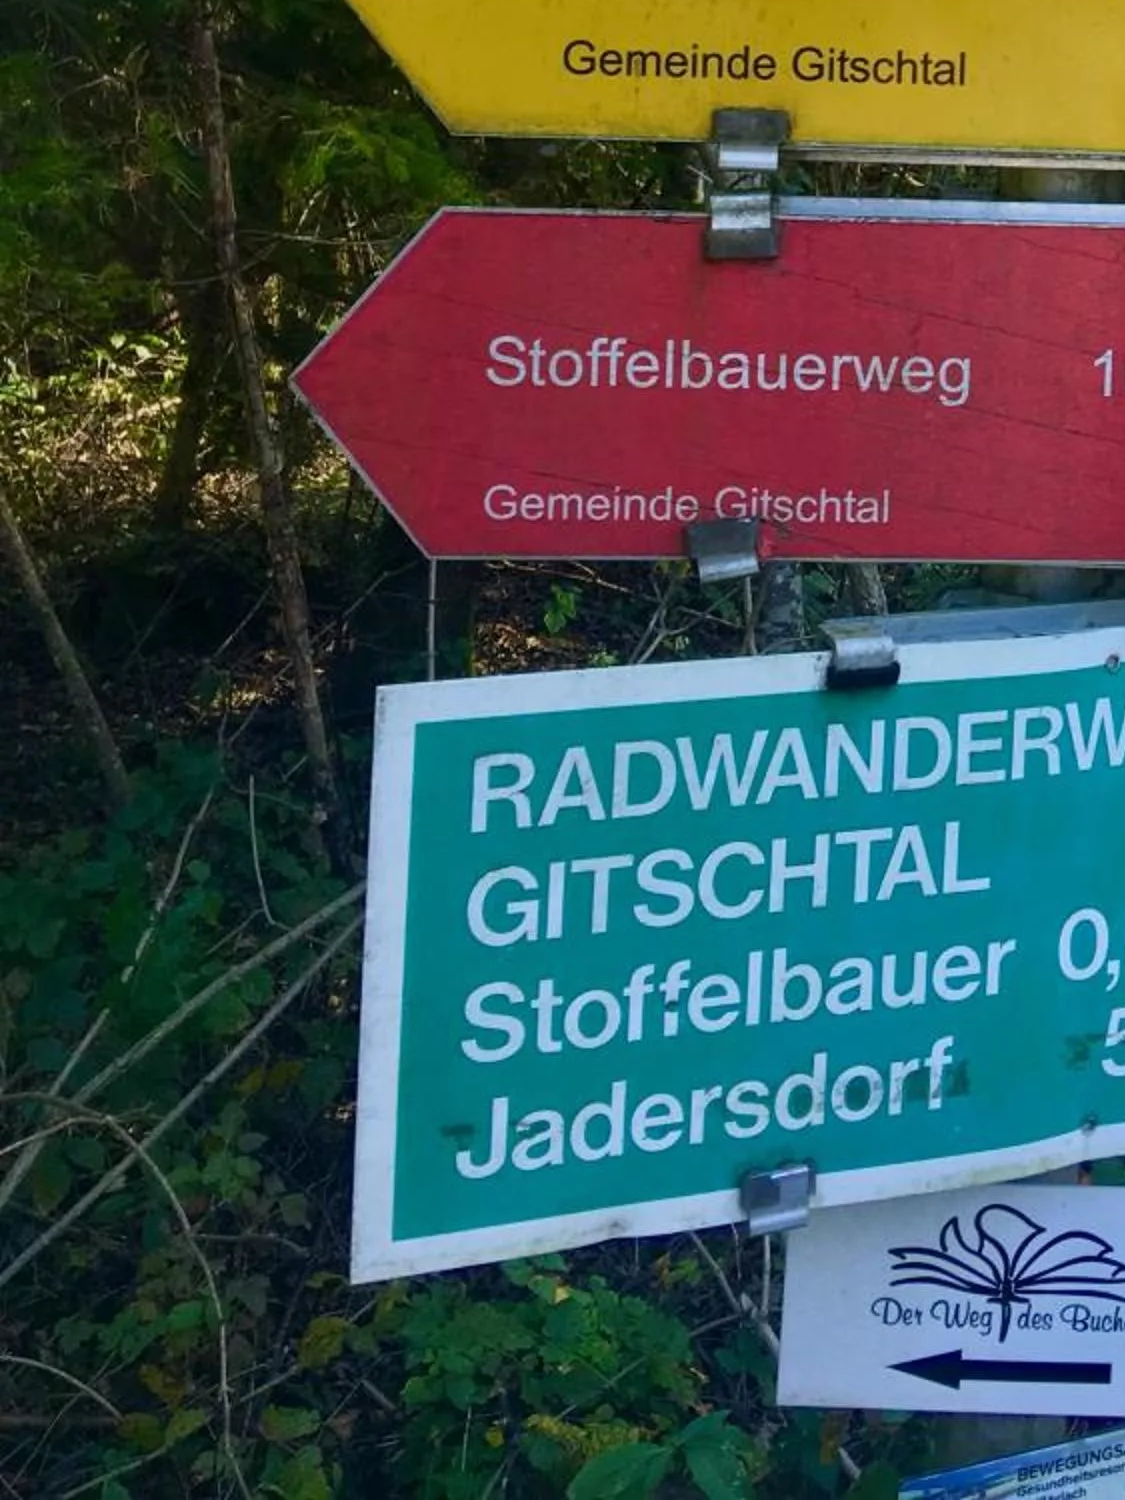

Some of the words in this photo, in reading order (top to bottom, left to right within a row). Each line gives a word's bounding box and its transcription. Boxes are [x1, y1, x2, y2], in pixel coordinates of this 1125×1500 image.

[562, 40, 777, 81] Gemeinde
[791, 47, 967, 87] Gitschtal
[485, 334, 972, 407] Stoffelbauerweg
[483, 483, 700, 523] Gemeinde
[715, 484, 890, 524] Gitschtal
[466, 821, 991, 948] GITSCHTAL
[461, 938, 1018, 1064] Stoffelbauer
[454, 1035, 956, 1180] Jadersdorf
[871, 1297, 923, 1327] Der
[929, 1299, 993, 1337] Weg
[1016, 1298, 1054, 1331] des
